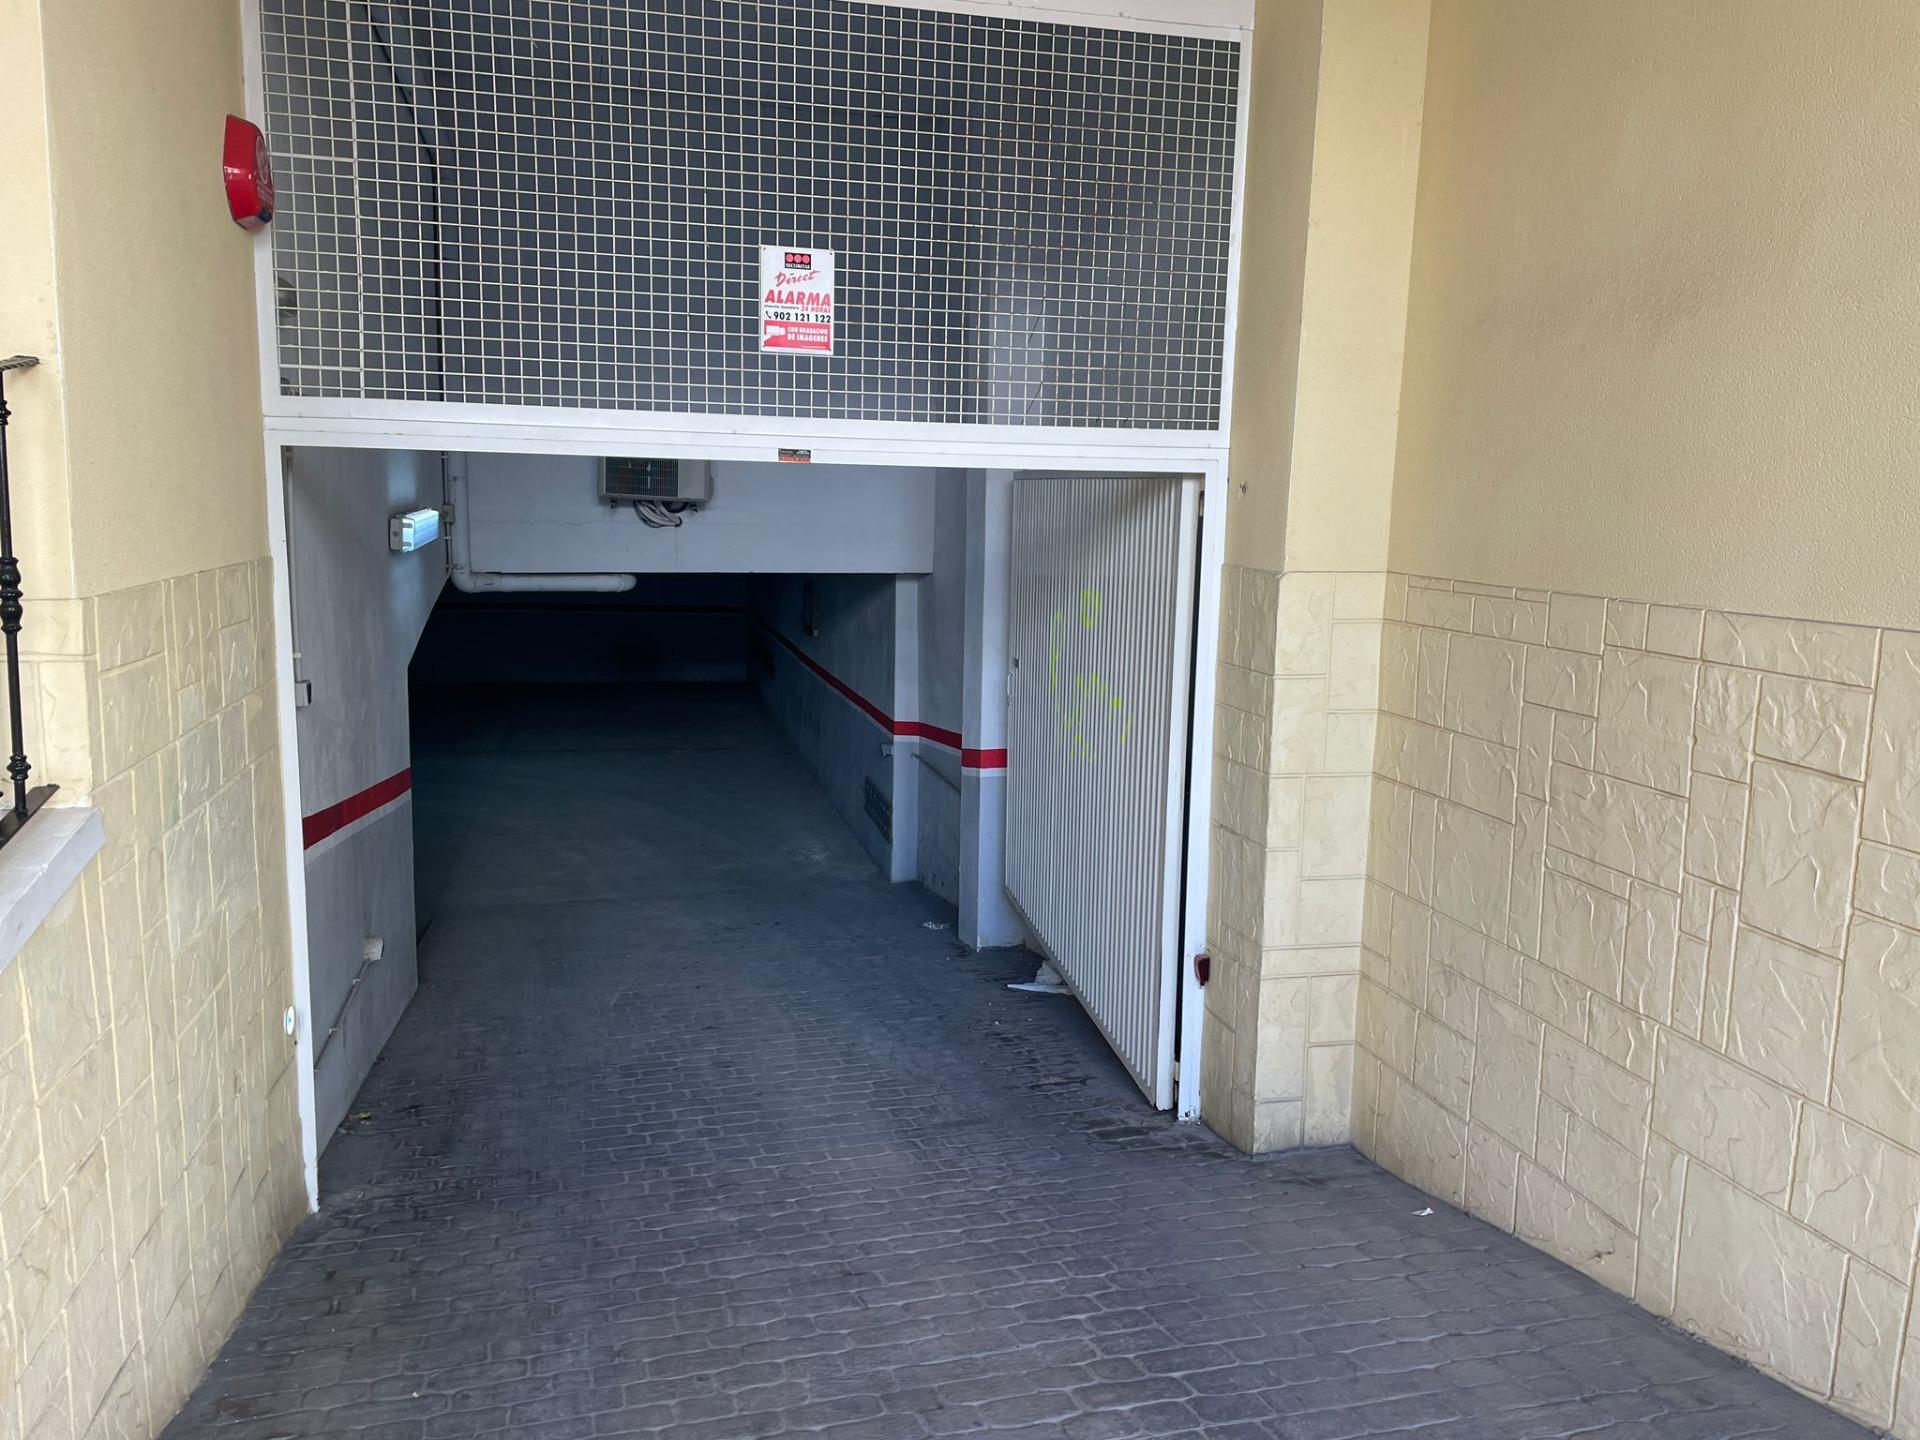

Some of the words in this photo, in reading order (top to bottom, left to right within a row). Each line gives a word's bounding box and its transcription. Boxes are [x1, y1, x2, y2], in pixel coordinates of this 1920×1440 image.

[775, 270, 821, 287] Direct
[764, 289, 831, 307] ALARMA
[773, 312, 791, 321] 902
[795, 313, 810, 322] 121
[815, 314, 831, 323] 122
[787, 333, 795, 341] DE
[796, 334, 828, 342] IMAGENES
